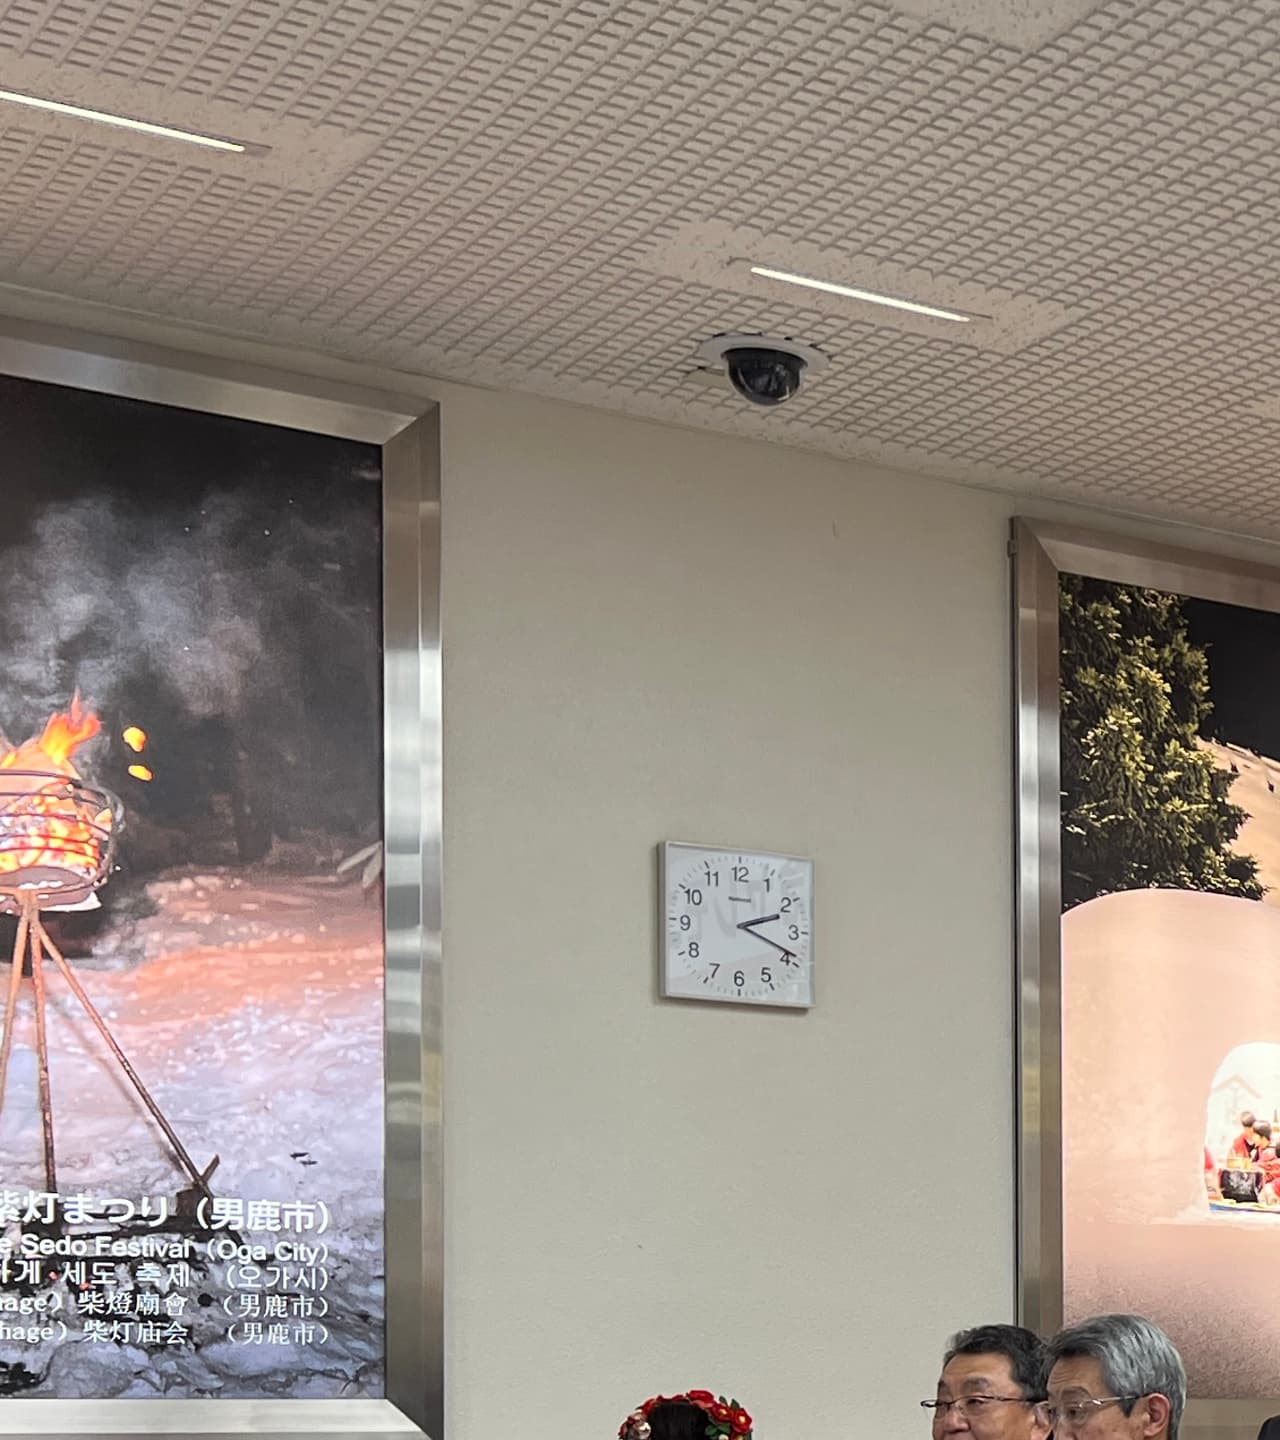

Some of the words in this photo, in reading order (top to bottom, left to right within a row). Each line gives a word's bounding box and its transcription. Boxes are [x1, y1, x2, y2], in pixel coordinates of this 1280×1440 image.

[704, 871, 719, 888] 11
[731, 866, 749, 883] 12
[763, 878, 771, 893] 1
[684, 889, 703, 906] 10
[780, 897, 792, 913] 2
[680, 914, 691, 931] 9
[788, 924, 799, 941] 3
[688, 941, 700, 958] 8
[780, 950, 791, 966] 4
[709, 963, 721, 979] 7
[733, 970, 745, 987] 6
[761, 967, 772, 983] 5
[21, 1233, 87, 1256] Sedo
[95, 1236, 190, 1258] Festival
[207, 1239, 266, 1264] (Oga
[274, 1241, 328, 1266] City)
[61, 1261, 117, 1285] 세도
[136, 1263, 189, 1287] 축제
